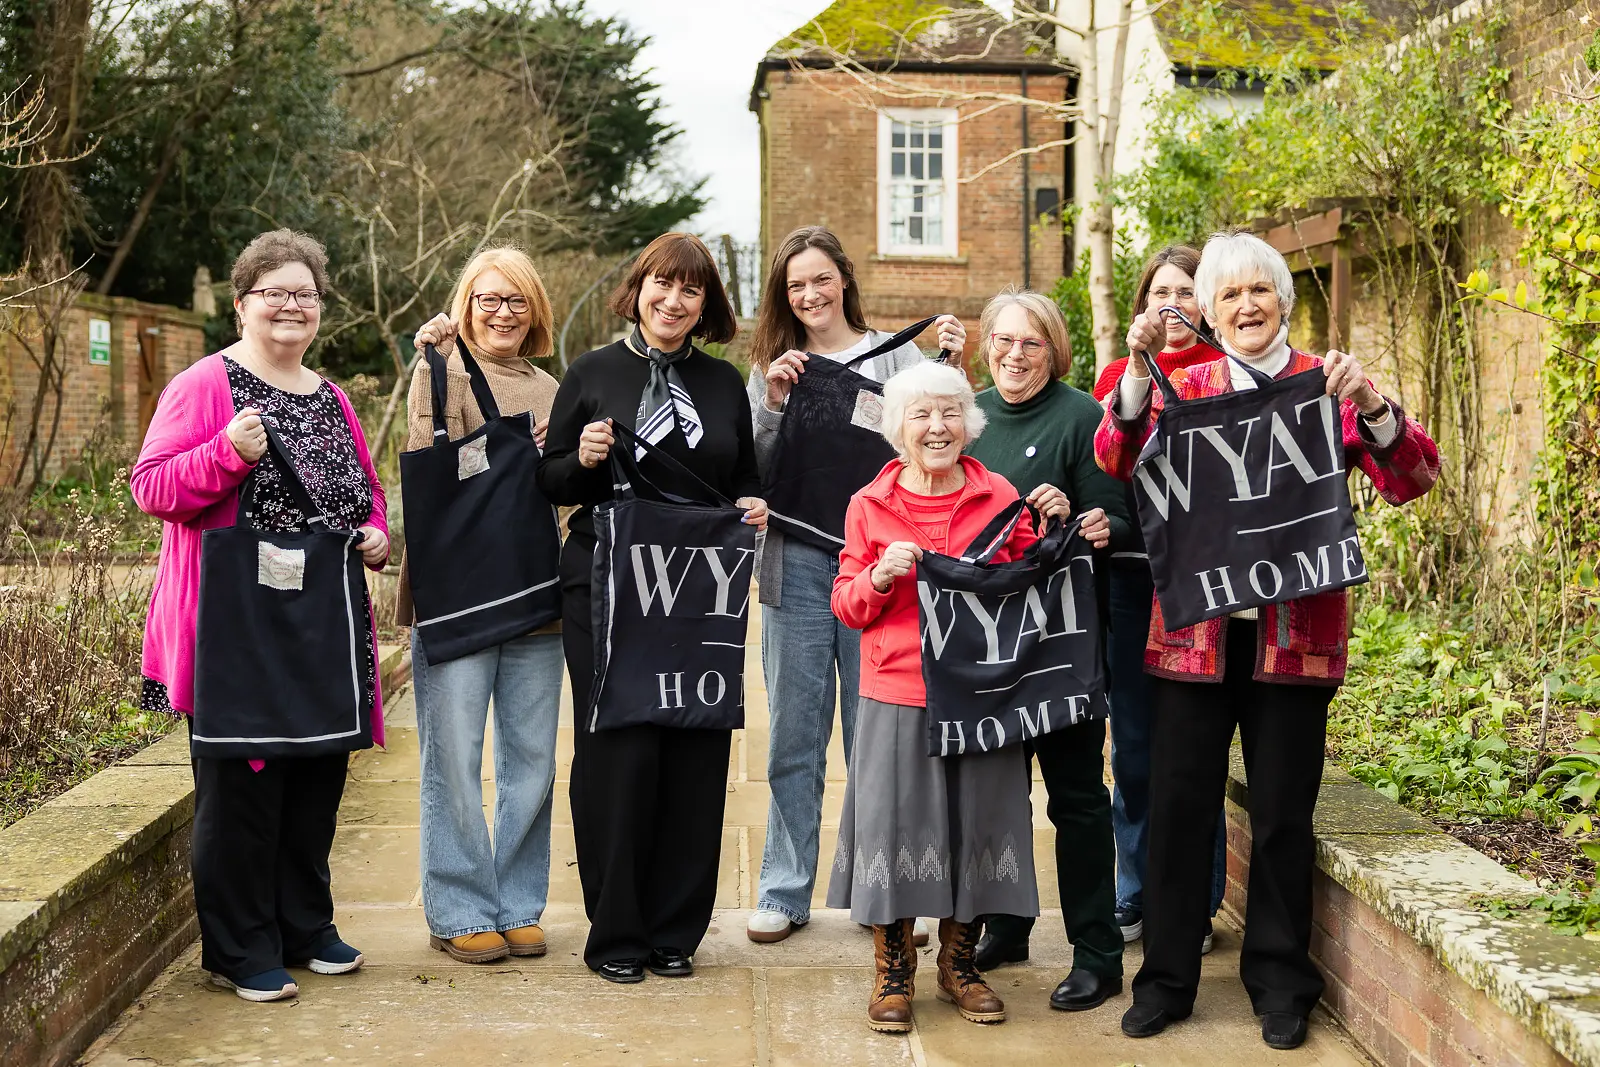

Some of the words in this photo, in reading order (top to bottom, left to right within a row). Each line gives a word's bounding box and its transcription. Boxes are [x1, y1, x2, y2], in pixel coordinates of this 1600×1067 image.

[630, 544, 754, 618] WY
[1195, 536, 1367, 611] HOME
[655, 670, 744, 709] HO
[938, 694, 1093, 756] HOME
